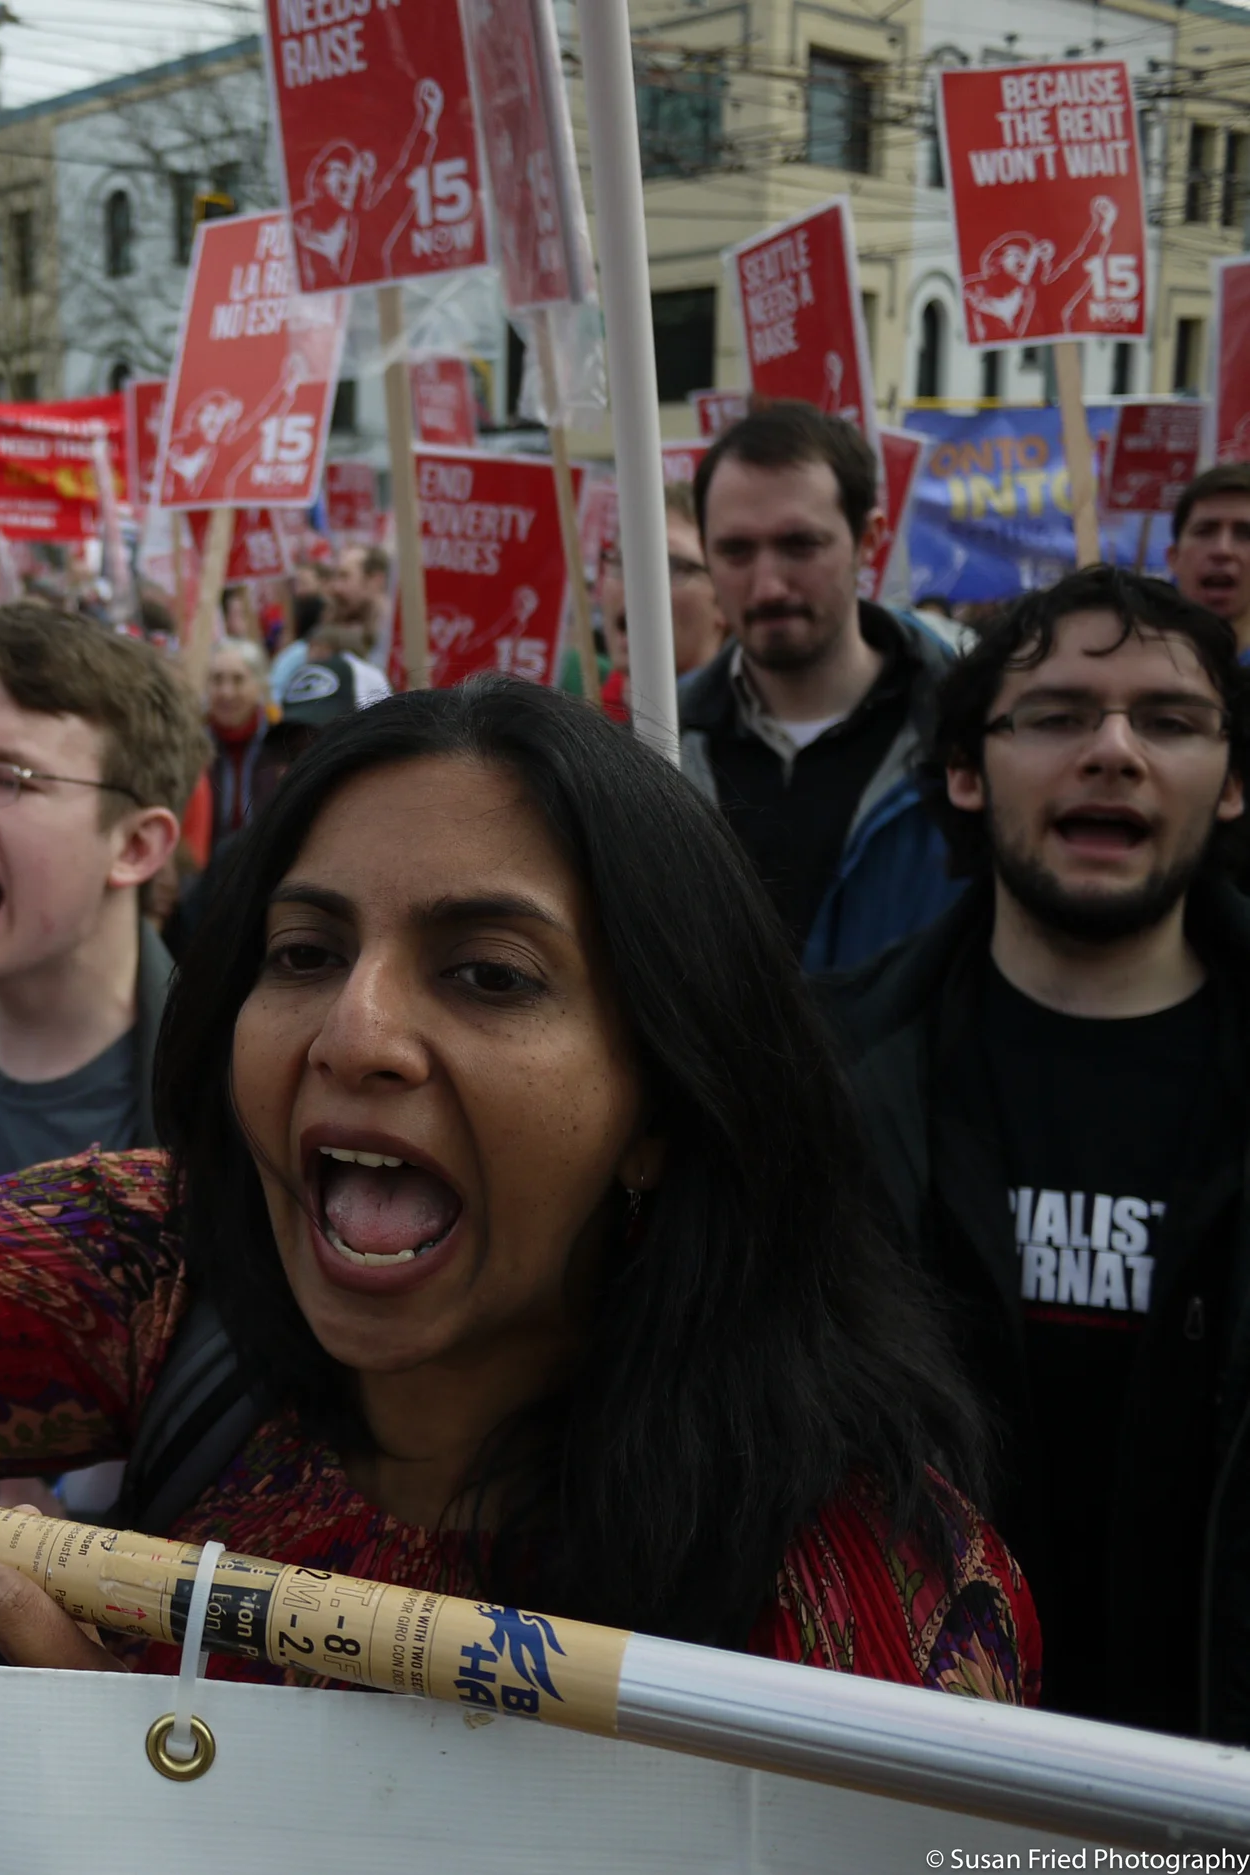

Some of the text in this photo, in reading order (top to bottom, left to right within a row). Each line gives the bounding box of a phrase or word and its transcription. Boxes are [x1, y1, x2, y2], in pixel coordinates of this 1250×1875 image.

[281, 20, 367, 89] RAISE
[1001, 68, 1123, 110] BECAUSE
[995, 103, 1125, 148] THE RENT
[968, 141, 1129, 188] WON'T WAIT
[406, 157, 473, 228] 15
[411, 221, 475, 258] NOW
[1083, 254, 1139, 301] 15
[1089, 301, 1140, 323] NOW
[260, 414, 315, 464] 15
[251, 462, 309, 487] NOW
[421, 463, 474, 501] END
[494, 637, 548, 682] 15
[1008, 1185, 1167, 1257] IALIS
[1016, 1243, 1155, 1314] RNAT
[395, 1615, 411, 1642] GIRO
[413, 1615, 431, 1643] WITH
[392, 1644, 406, 1668] CON
[410, 1646, 425, 1670] TWO
